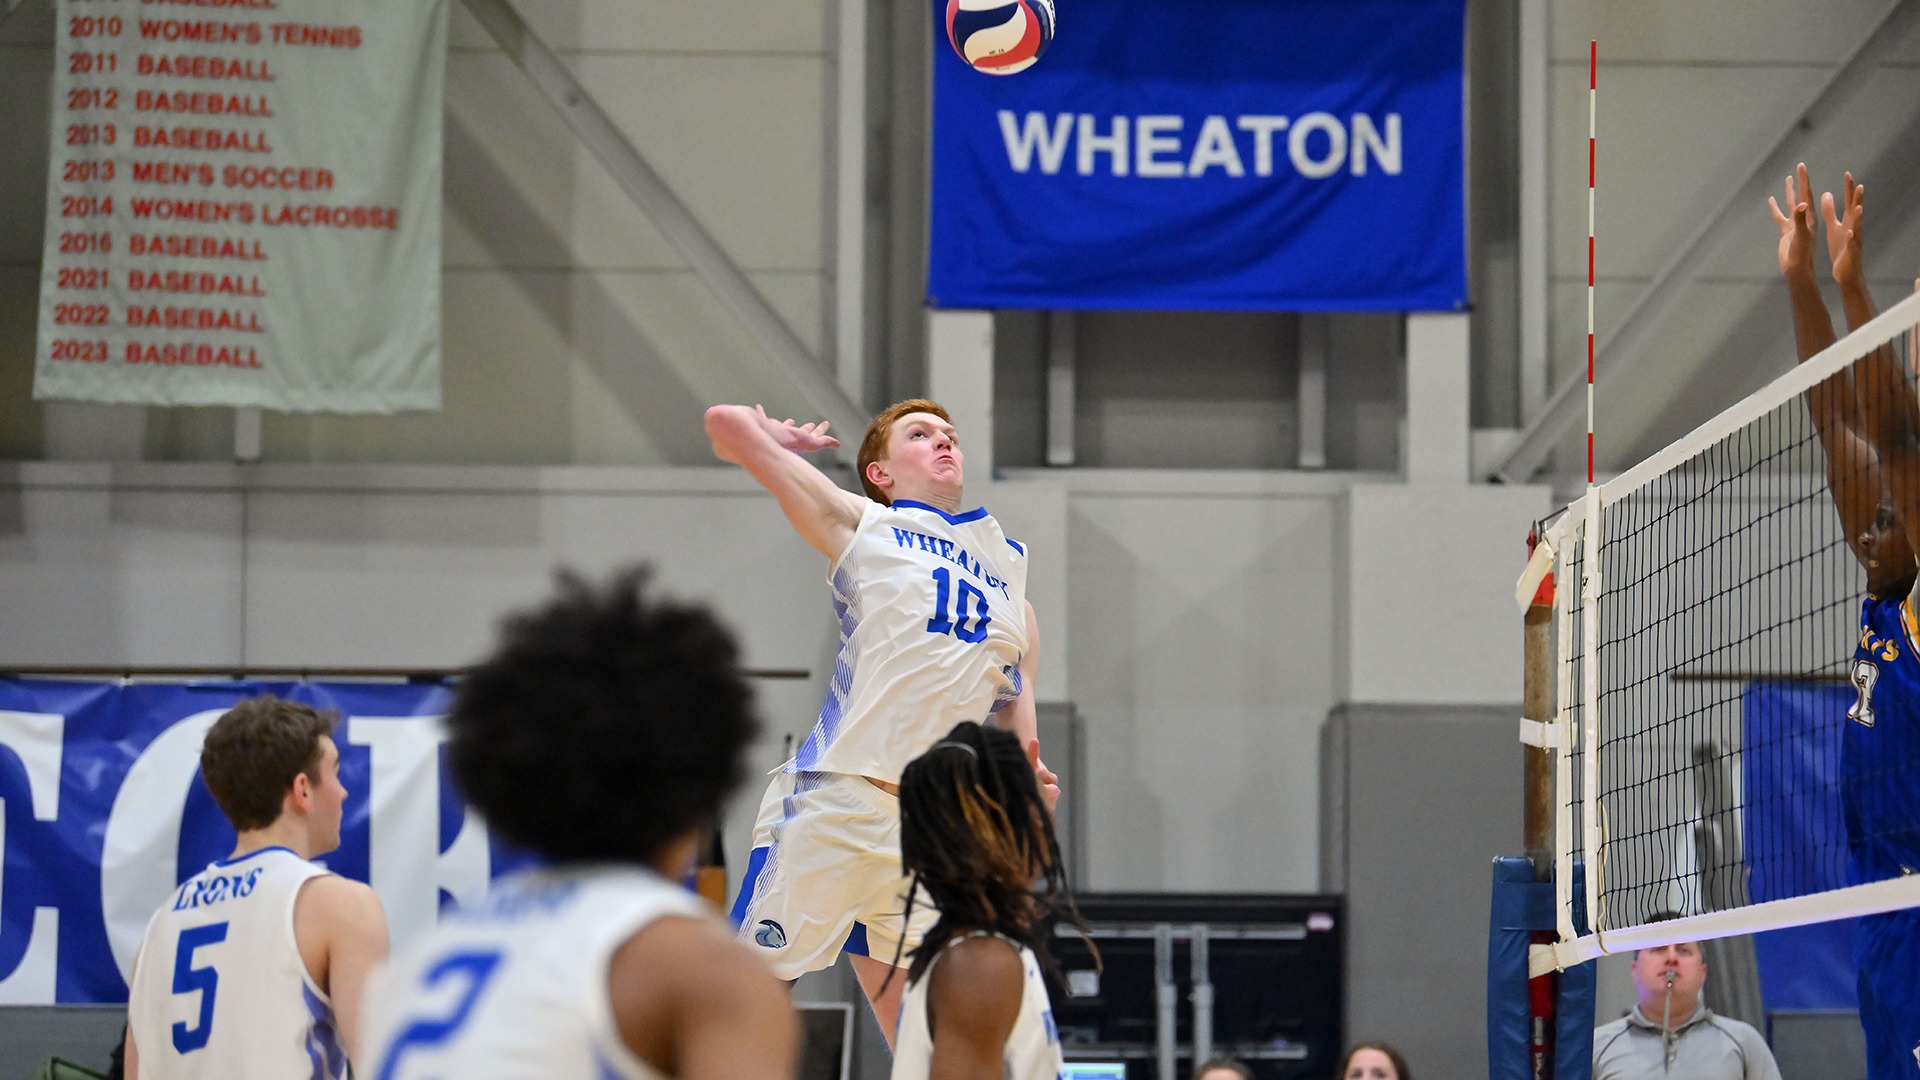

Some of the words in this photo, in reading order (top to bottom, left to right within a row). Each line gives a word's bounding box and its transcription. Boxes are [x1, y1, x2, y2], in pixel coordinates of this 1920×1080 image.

[69, 15, 123, 38] 2010
[139, 19, 262, 45] WOMEN'S
[271, 23, 362, 48] TENNIS
[69, 52, 117, 74] 2011
[136, 53, 273, 81] BASEBALL
[68, 88, 119, 110] 2012
[134, 90, 272, 117] BASEBALL
[66, 123, 117, 145] 2013
[133, 125, 270, 153] BASEBALL
[996, 110, 1402, 179] WHEATON
[63, 159, 116, 182] 2013
[132, 161, 215, 186] MEN'S
[223, 164, 334, 191] SOCCER
[62, 196, 113, 217] 2014
[130, 198, 255, 223] WOMEN'S
[261, 203, 399, 230] LACROSSE
[60, 232, 112, 254] 2016
[129, 234, 266, 261] BASEBALL
[57, 267, 109, 289] 2021
[127, 269, 265, 297] BASEBALL
[53, 303, 110, 326] 2022
[126, 306, 264, 333] BASEBALL
[50, 339, 109, 362] 2023
[124, 341, 262, 369] BASEBALL
[926, 566, 992, 643] 10
[172, 867, 263, 911] LYONS
[172, 921, 229, 1055] 5
[374, 946, 504, 1080] 2
